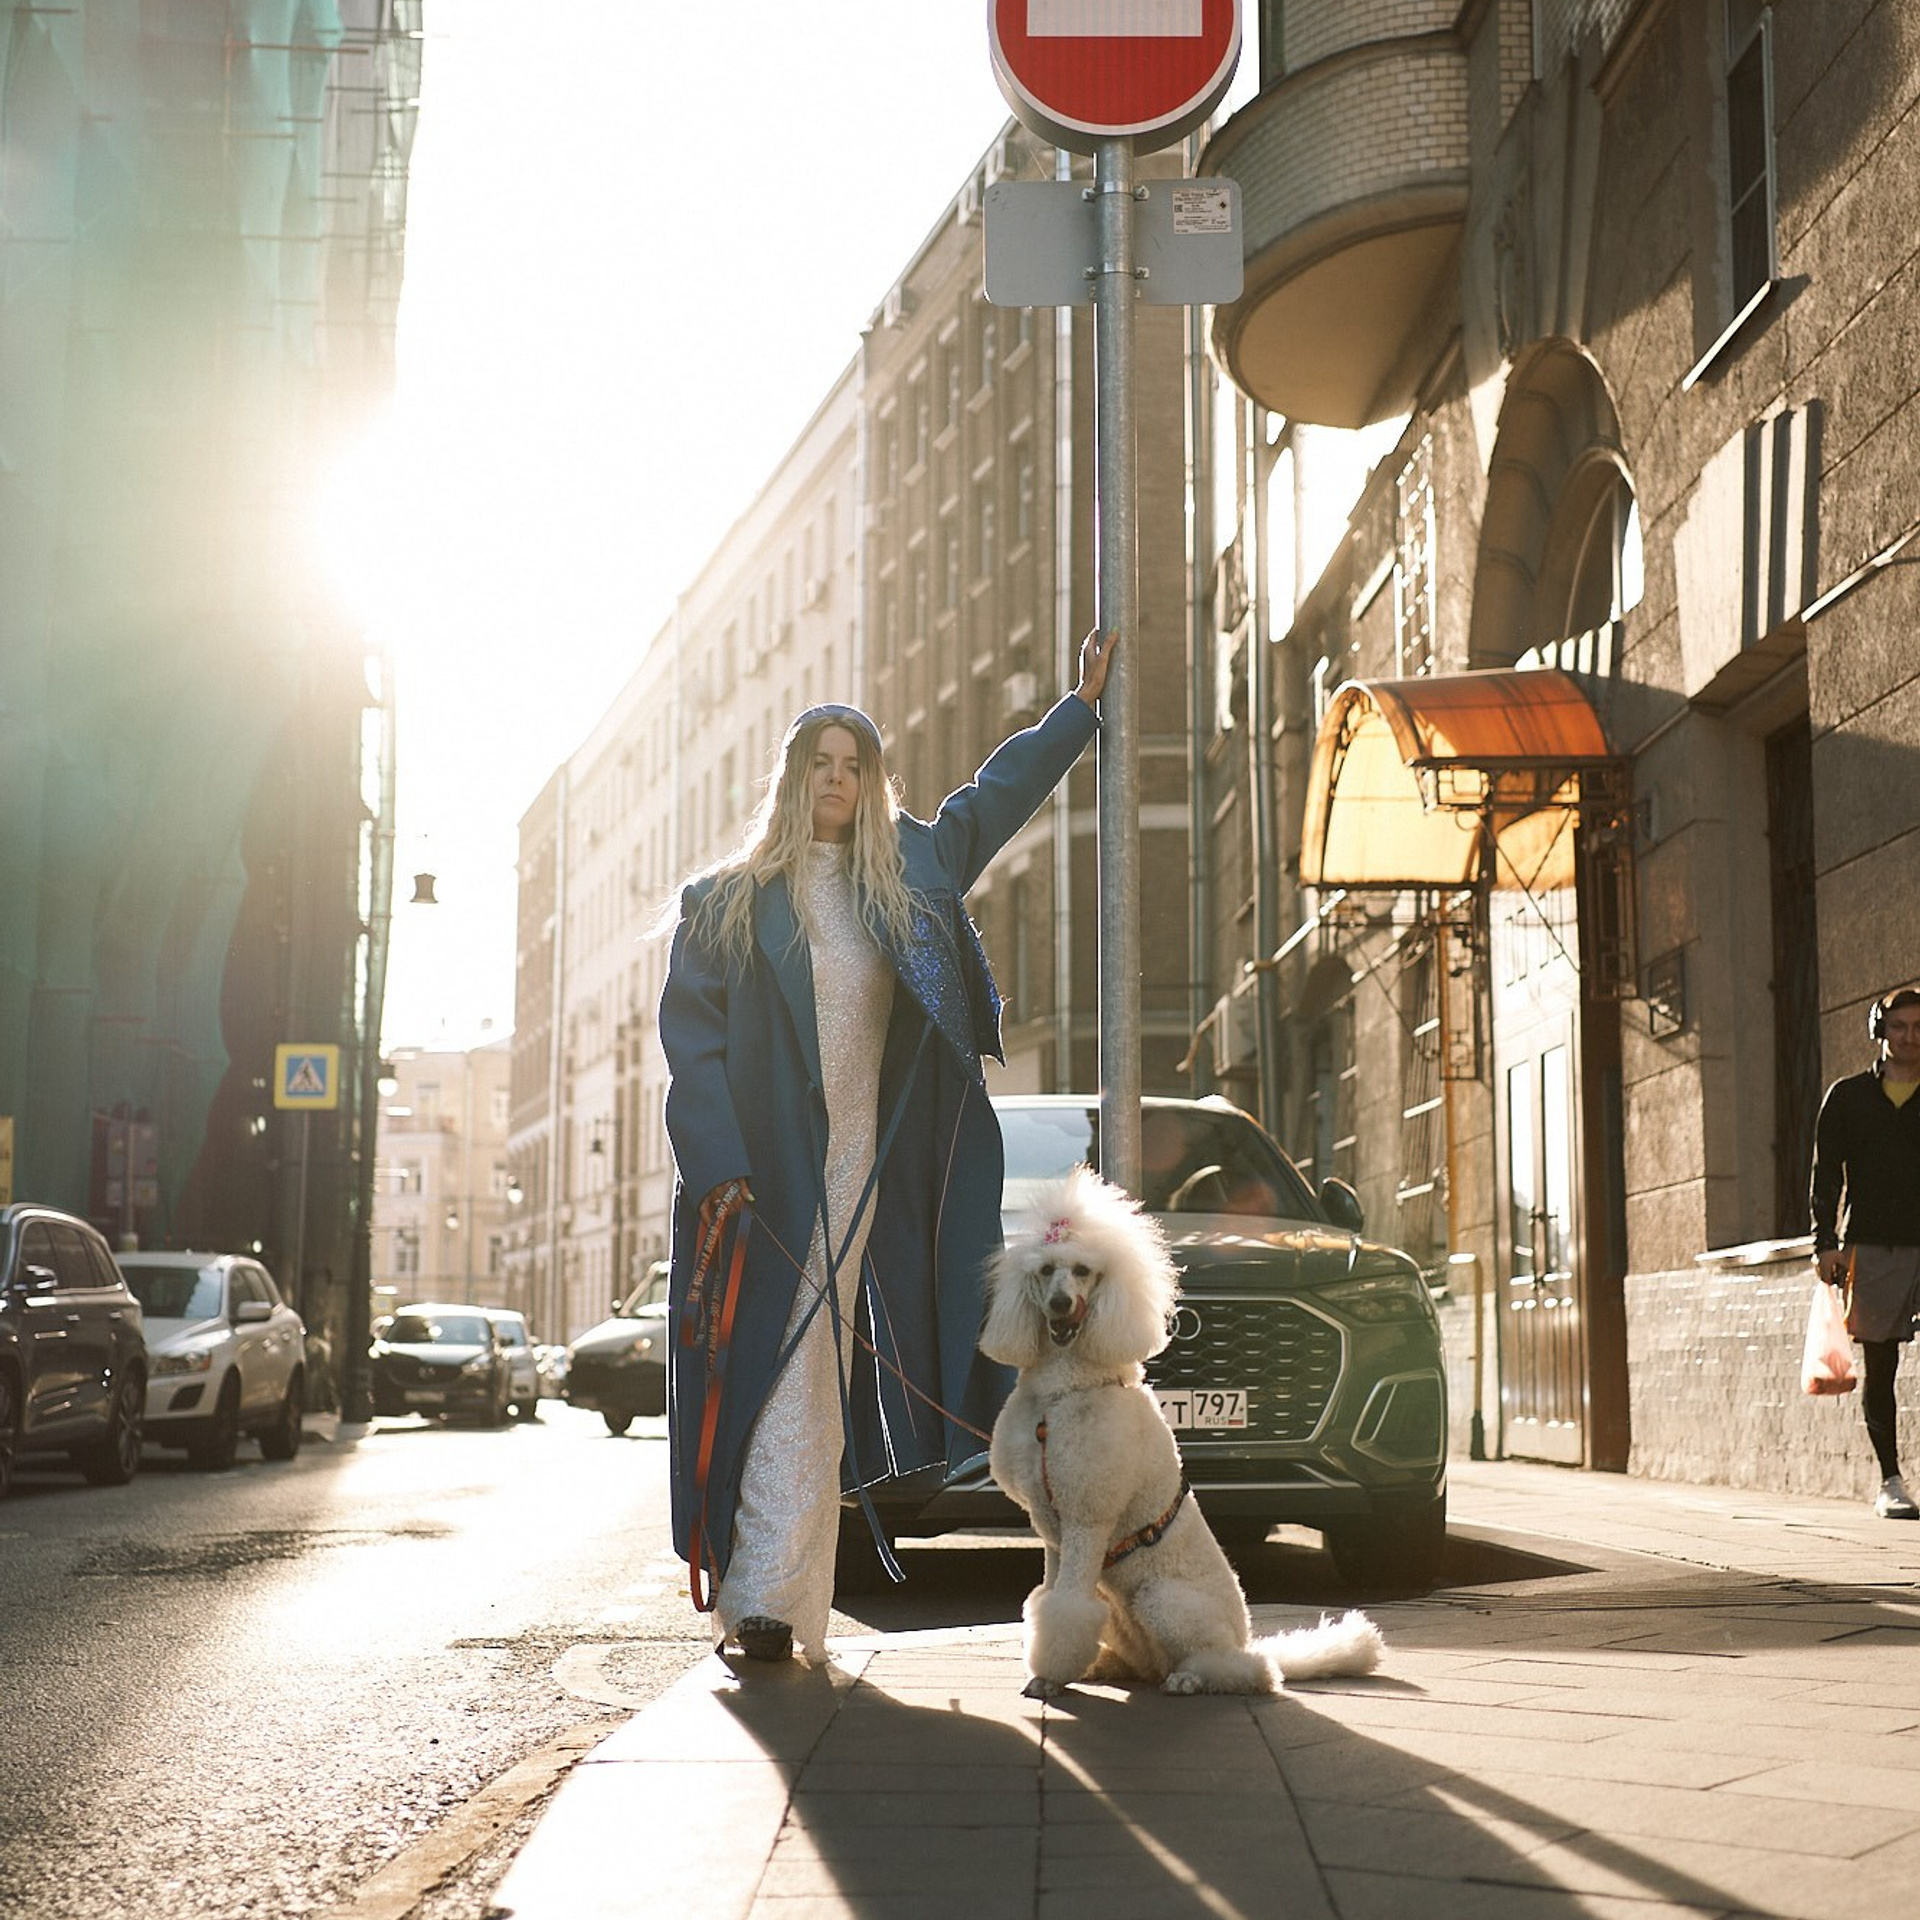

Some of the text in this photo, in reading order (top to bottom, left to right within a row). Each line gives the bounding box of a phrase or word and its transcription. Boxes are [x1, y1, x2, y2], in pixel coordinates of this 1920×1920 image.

[1160, 1393, 1240, 1424] T 797
[1205, 1416, 1227, 1426] RUS
